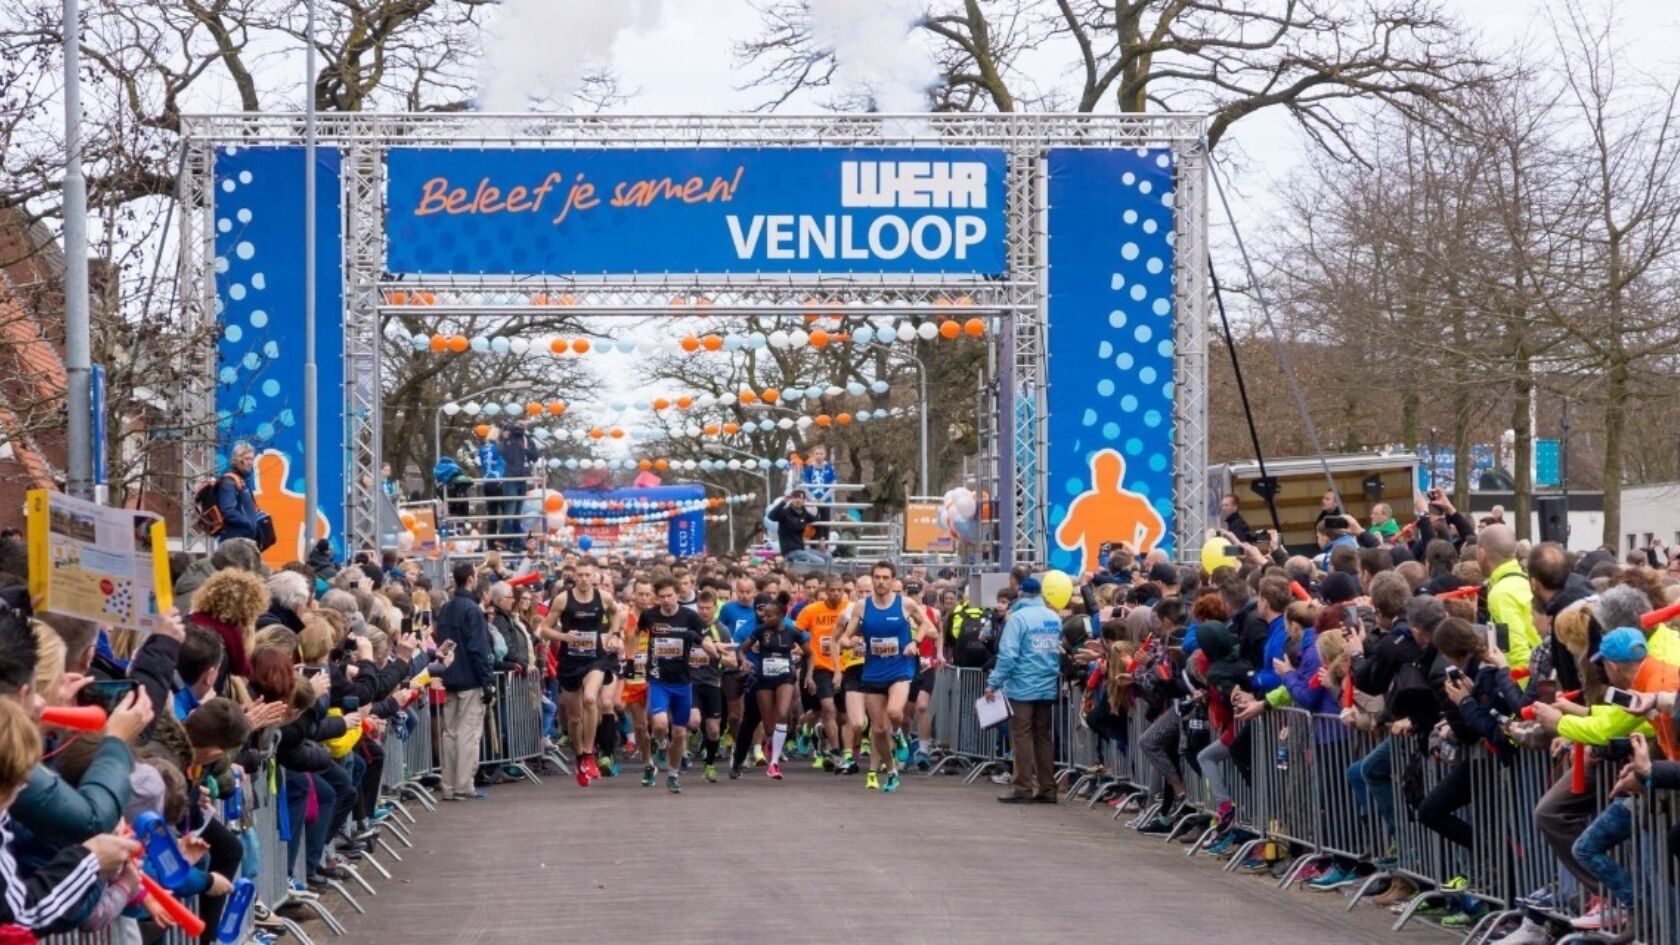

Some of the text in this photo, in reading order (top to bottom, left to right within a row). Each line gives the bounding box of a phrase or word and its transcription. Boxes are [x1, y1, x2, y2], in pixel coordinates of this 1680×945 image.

[415, 167, 744, 224] Beleef je samen!
[841, 161, 987, 209] WEIR
[726, 214, 988, 260] VENLOOP
